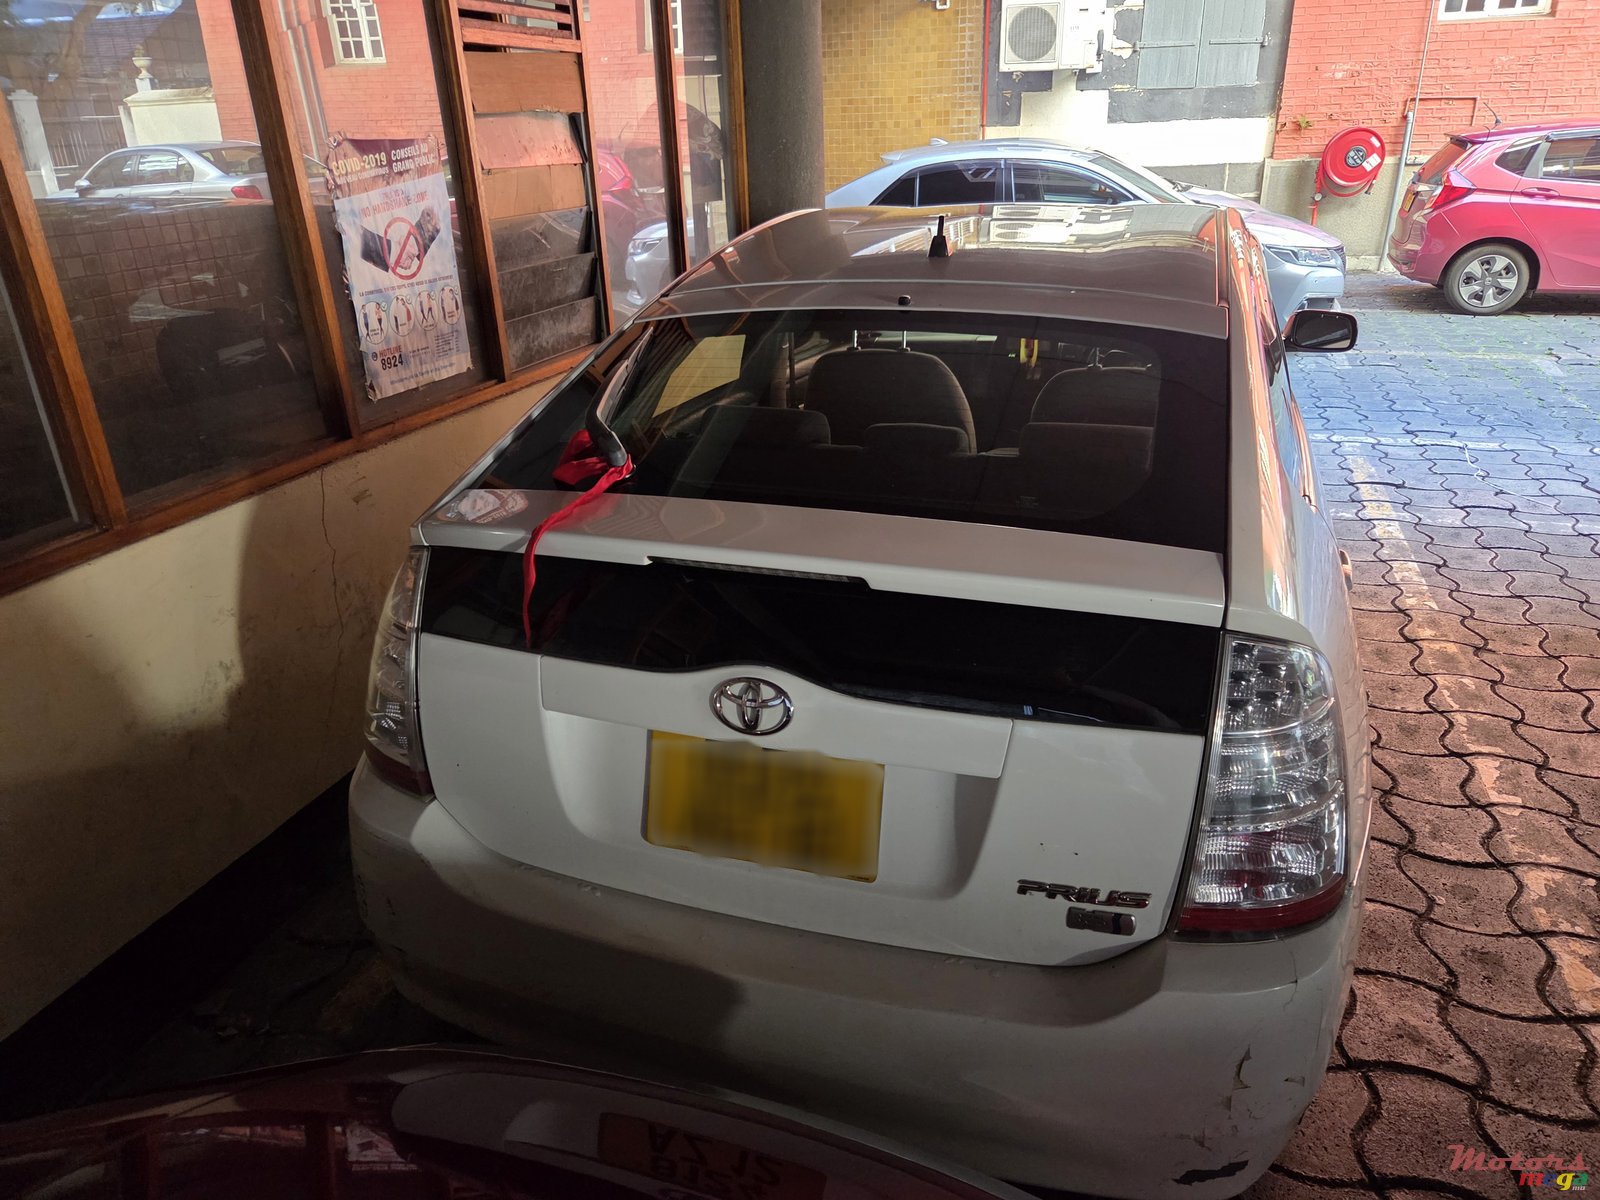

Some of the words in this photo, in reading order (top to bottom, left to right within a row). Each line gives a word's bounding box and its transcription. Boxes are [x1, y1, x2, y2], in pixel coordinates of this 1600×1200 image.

[391, 144, 420, 161] CONSEILS
[332, 152, 387, 176] COVID-2019
[392, 158, 414, 173] GRAND
[414, 153, 435, 168] PUBLIC
[360, 206, 371, 218] NO
[379, 344, 402, 358] HOTLINE
[380, 353, 404, 371] 8924
[1016, 878, 1152, 909] PRIUS
